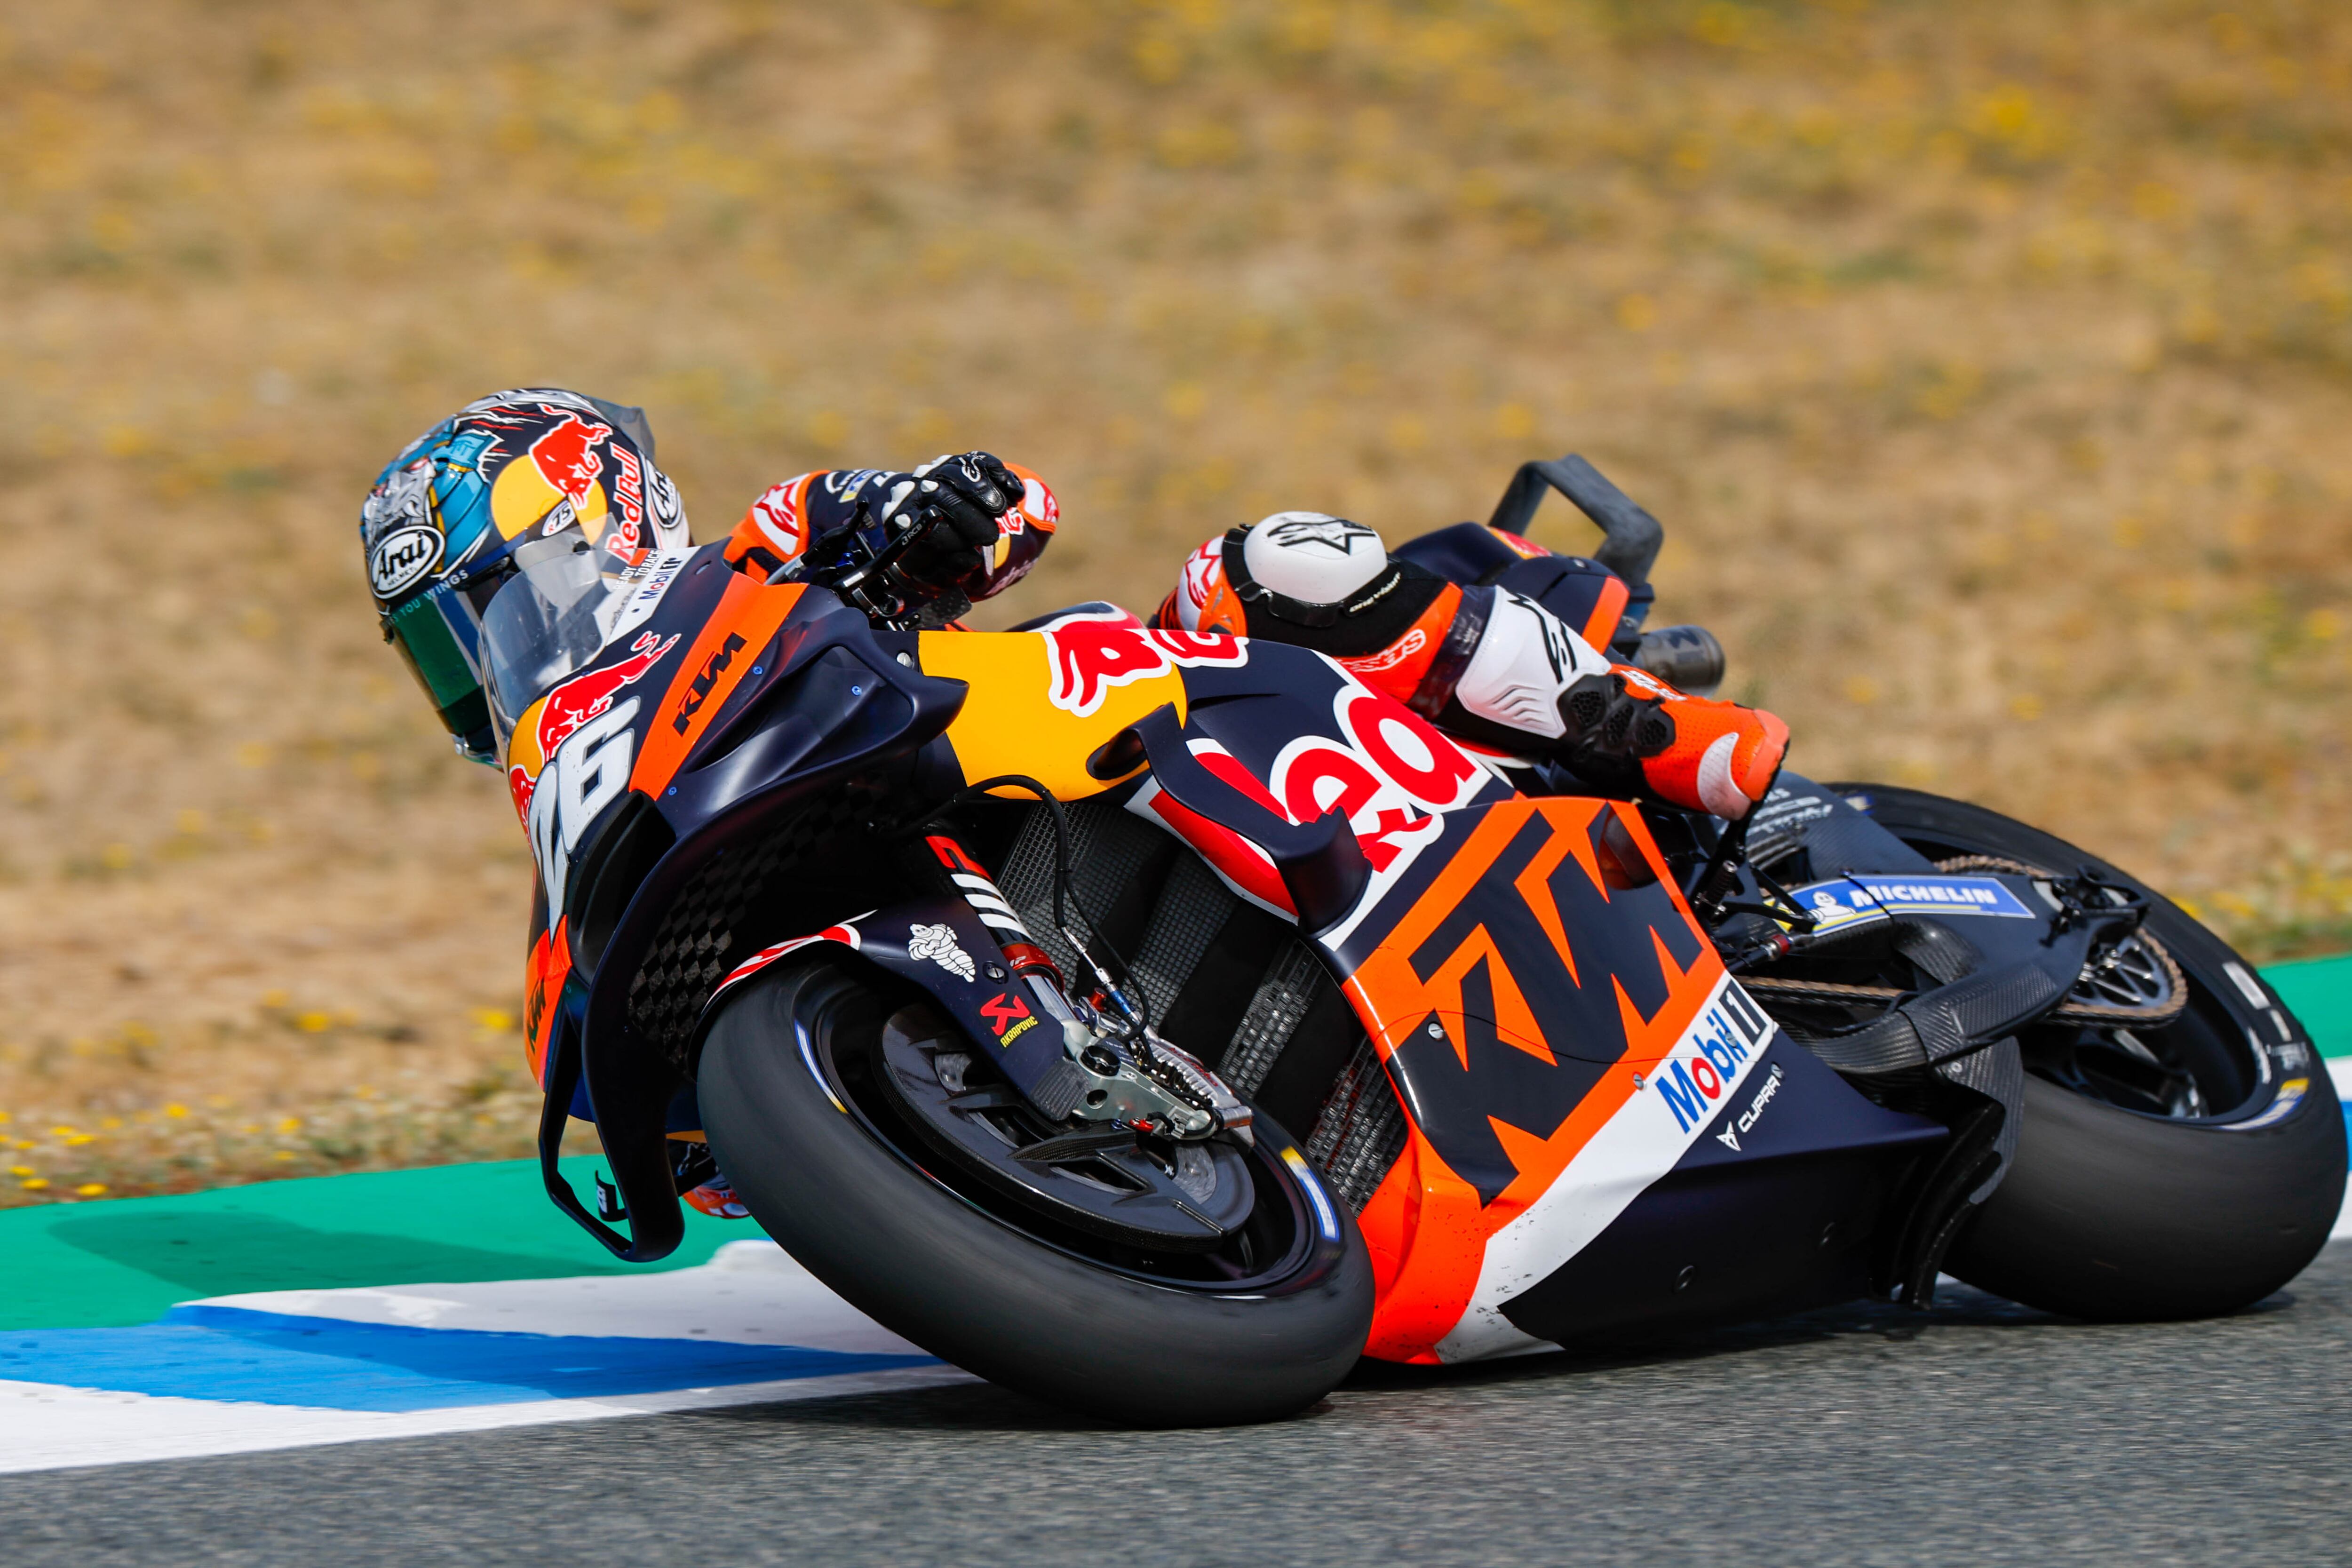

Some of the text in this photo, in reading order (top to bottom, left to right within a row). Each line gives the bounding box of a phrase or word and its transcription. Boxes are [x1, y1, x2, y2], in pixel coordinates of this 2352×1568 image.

[609, 441, 643, 506] Bull
[605, 492, 643, 564] Red
[376, 531, 427, 587] Arai
[613, 566, 636, 590] READY
[639, 569, 674, 600] Mobil
[399, 569, 469, 618] YOU WINGS
[672, 632, 747, 737] KTM
[528, 695, 641, 949] 26
[1849, 884, 1997, 907] MICHELIN
[1387, 801, 1704, 1208] KTM
[1656, 1007, 1749, 1134] Mobil
[1722, 983, 1763, 1042] 1
[1737, 1075, 1780, 1133] CUPRA
